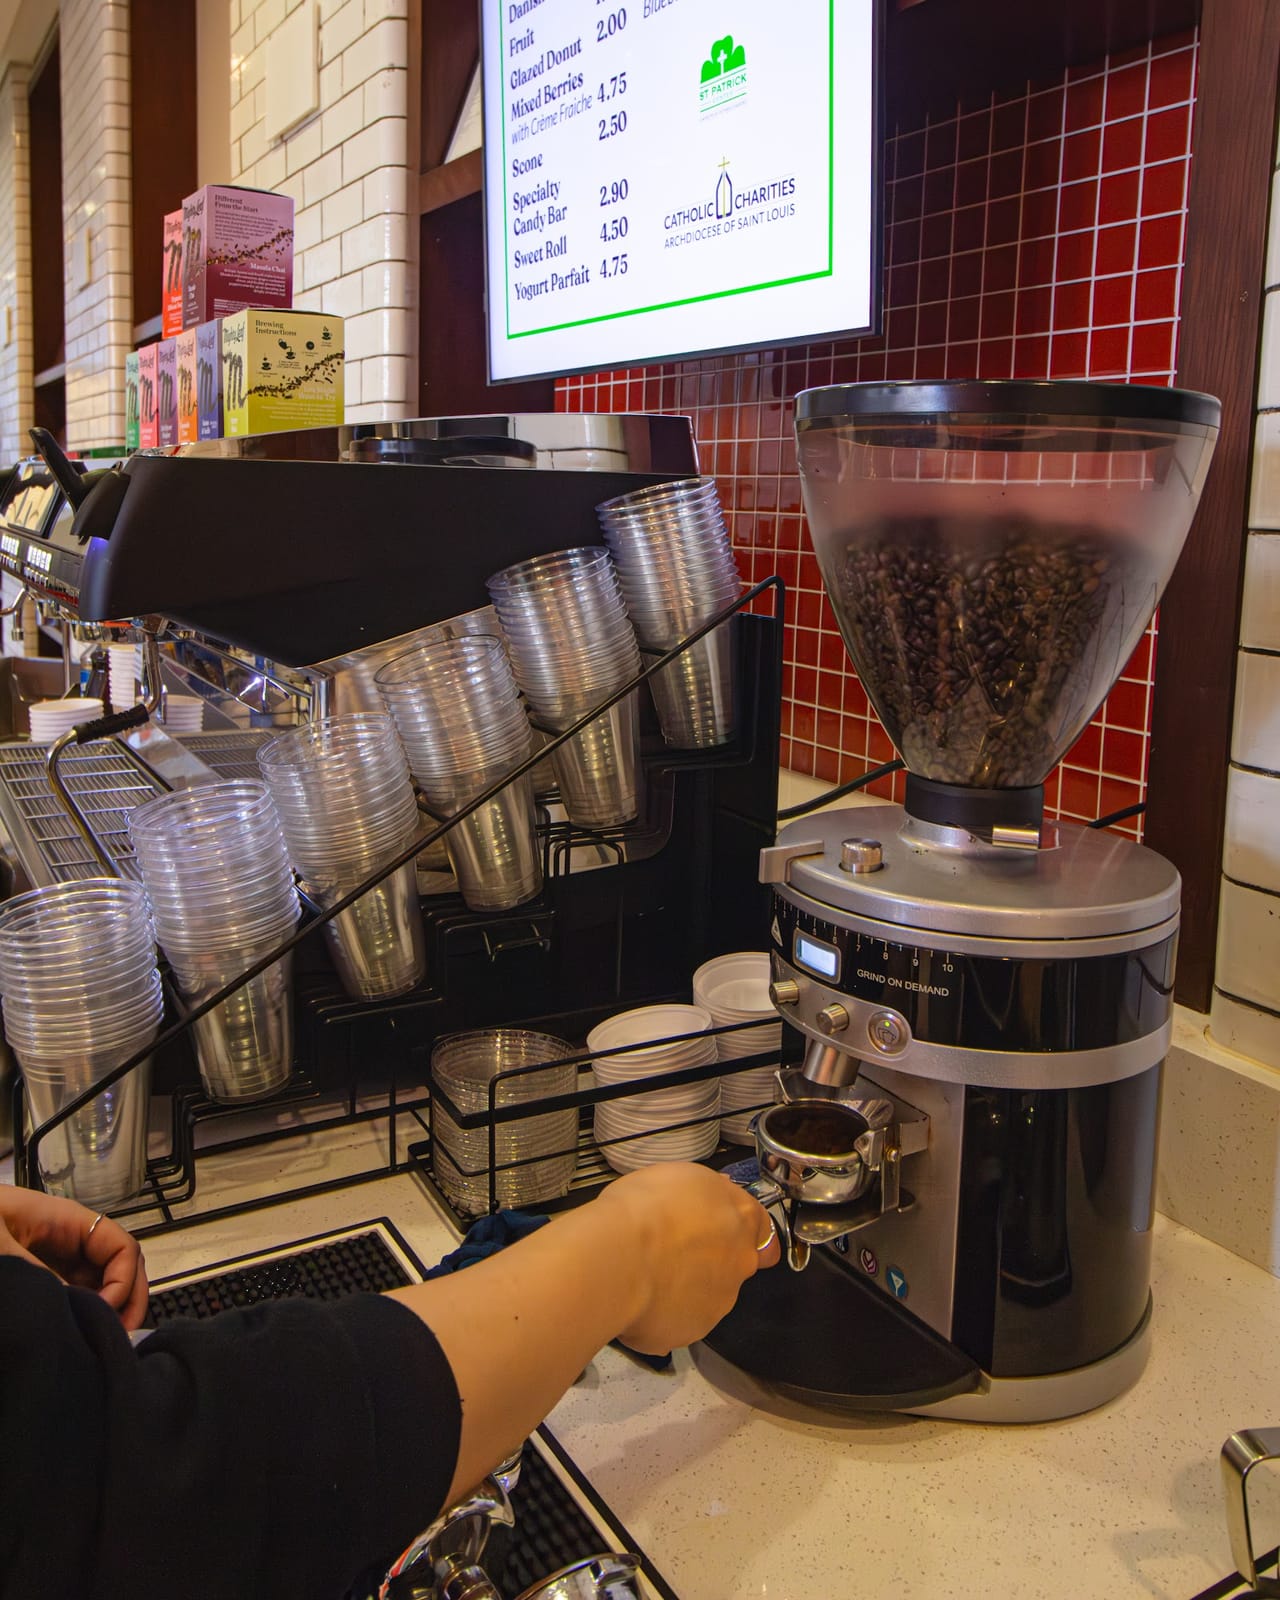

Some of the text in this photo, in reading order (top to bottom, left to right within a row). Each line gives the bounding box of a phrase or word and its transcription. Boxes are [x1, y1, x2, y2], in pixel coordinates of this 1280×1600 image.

[509, 0, 545, 24] Danis
[510, 28, 535, 58] Fruit
[510, 7, 627, 91] Glazed Donut 2.00
[511, 72, 584, 121] Mixed Berries
[512, 122, 529, 145] with
[531, 112, 558, 136] Crème
[597, 71, 627, 103] 4.75
[699, 89, 709, 101] ST
[711, 73, 747, 96] PATRICK
[512, 110, 627, 178] Scone 2.50
[513, 180, 561, 213] Specialty
[513, 178, 629, 236] Candy Bar 2.90
[664, 178, 796, 230] CATHOLIC CHARITIES
[514, 216, 629, 269] Sweet Roll 4.50
[664, 203, 795, 249] ARCHDIOCESE OF SAINT LOUIS
[514, 254, 629, 301] Yogurt Parfait 4.75
[255, 319, 284, 329] Brewing
[255, 327, 297, 336] Instructions
[857, 968, 950, 997] GRIND ON DEMAND
[883, 952, 889, 960] 8
[912, 958, 919, 967] 9
[942, 963, 954, 973] 10
